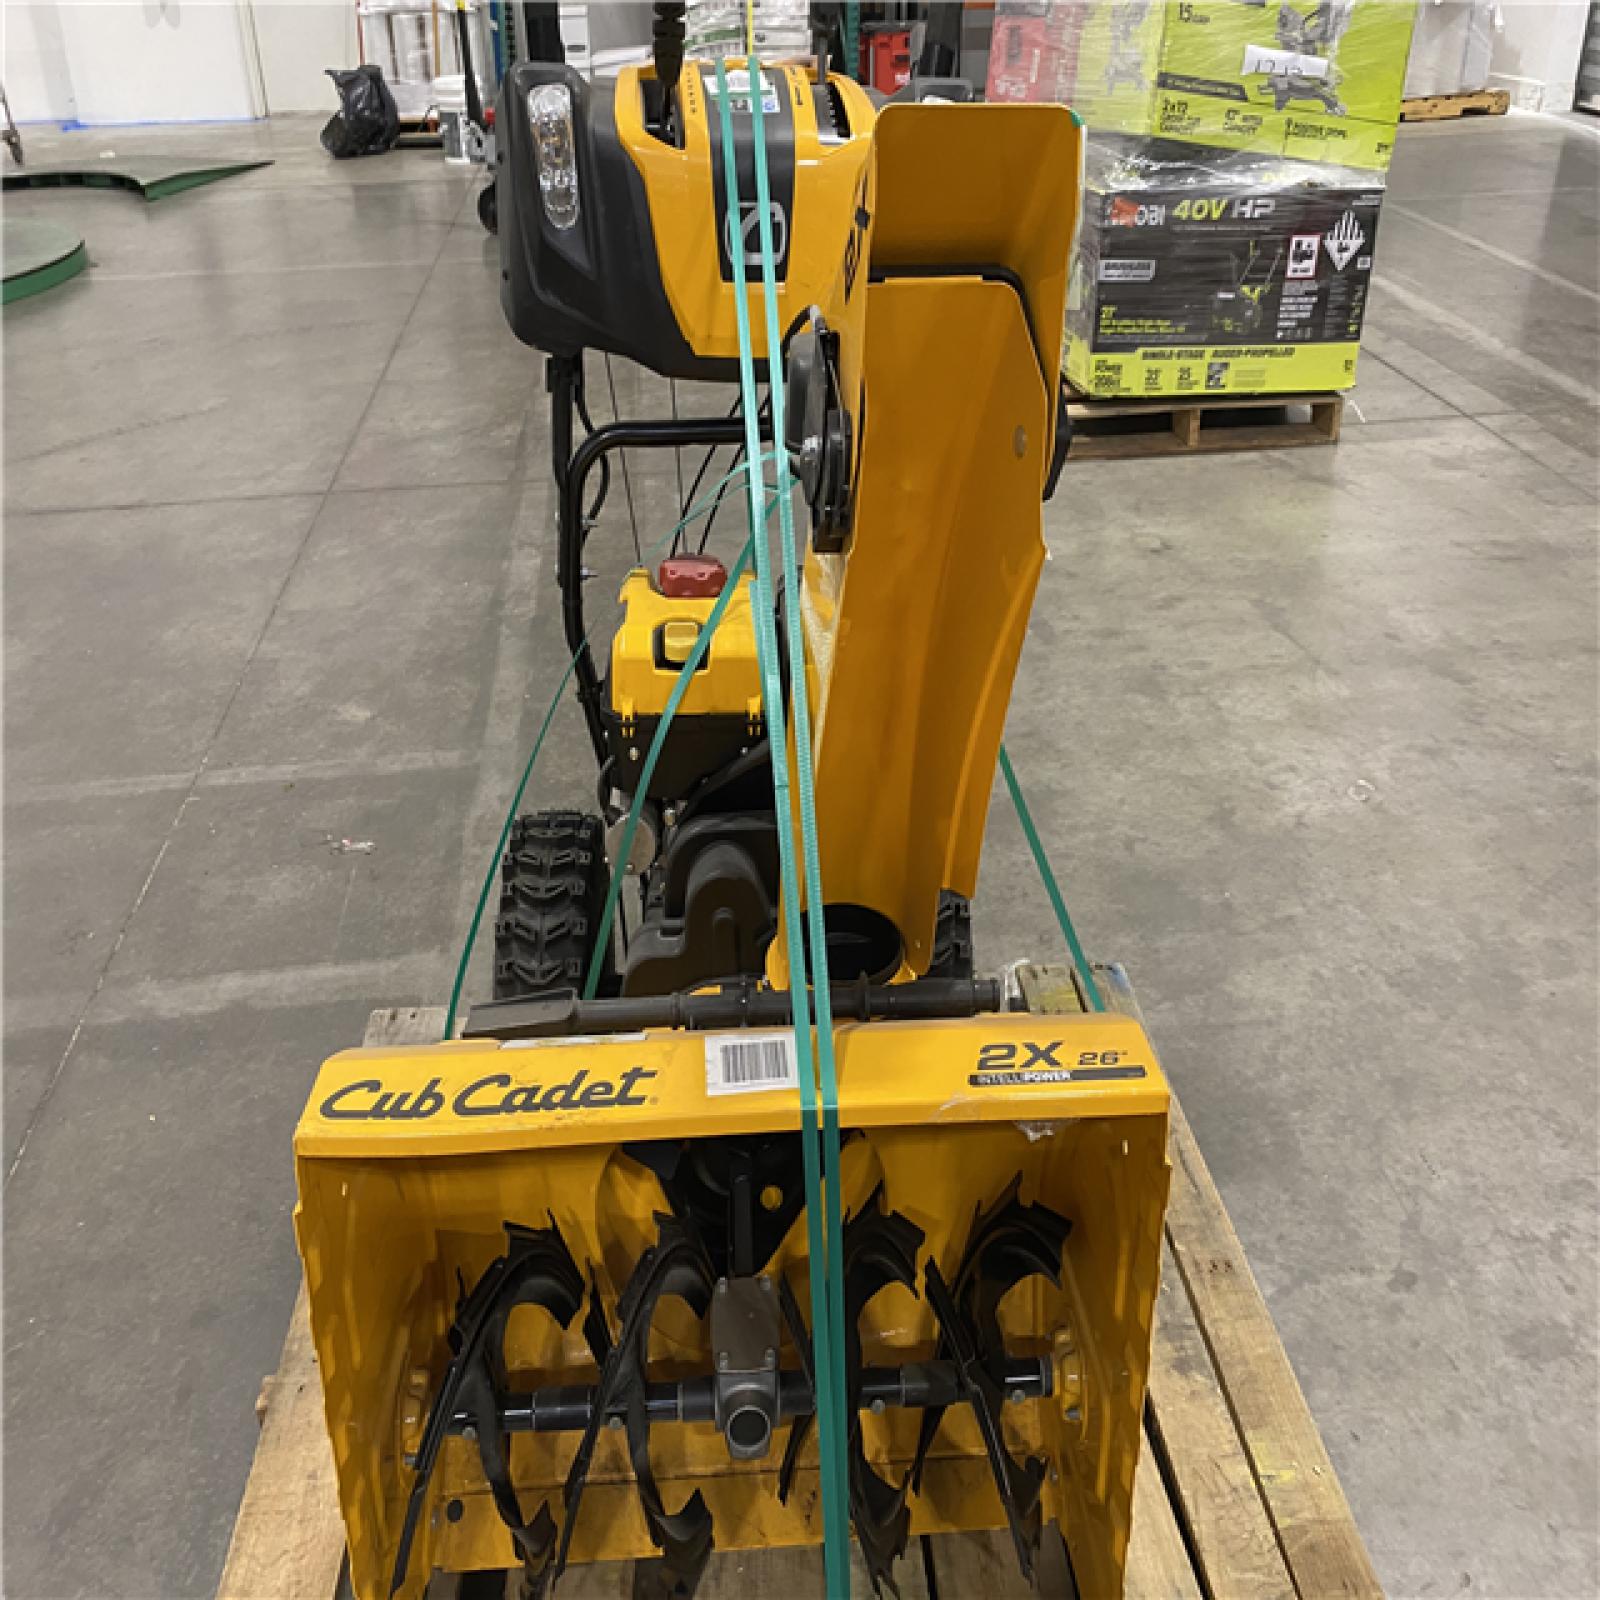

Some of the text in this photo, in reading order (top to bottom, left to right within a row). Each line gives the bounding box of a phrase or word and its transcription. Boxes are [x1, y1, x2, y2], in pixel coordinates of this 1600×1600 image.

[1172, 199, 1229, 222] 40V
[1232, 199, 1276, 219] HP
[977, 1040, 1065, 1071] 2X
[320, 1067, 658, 1120] Cub Cadet
